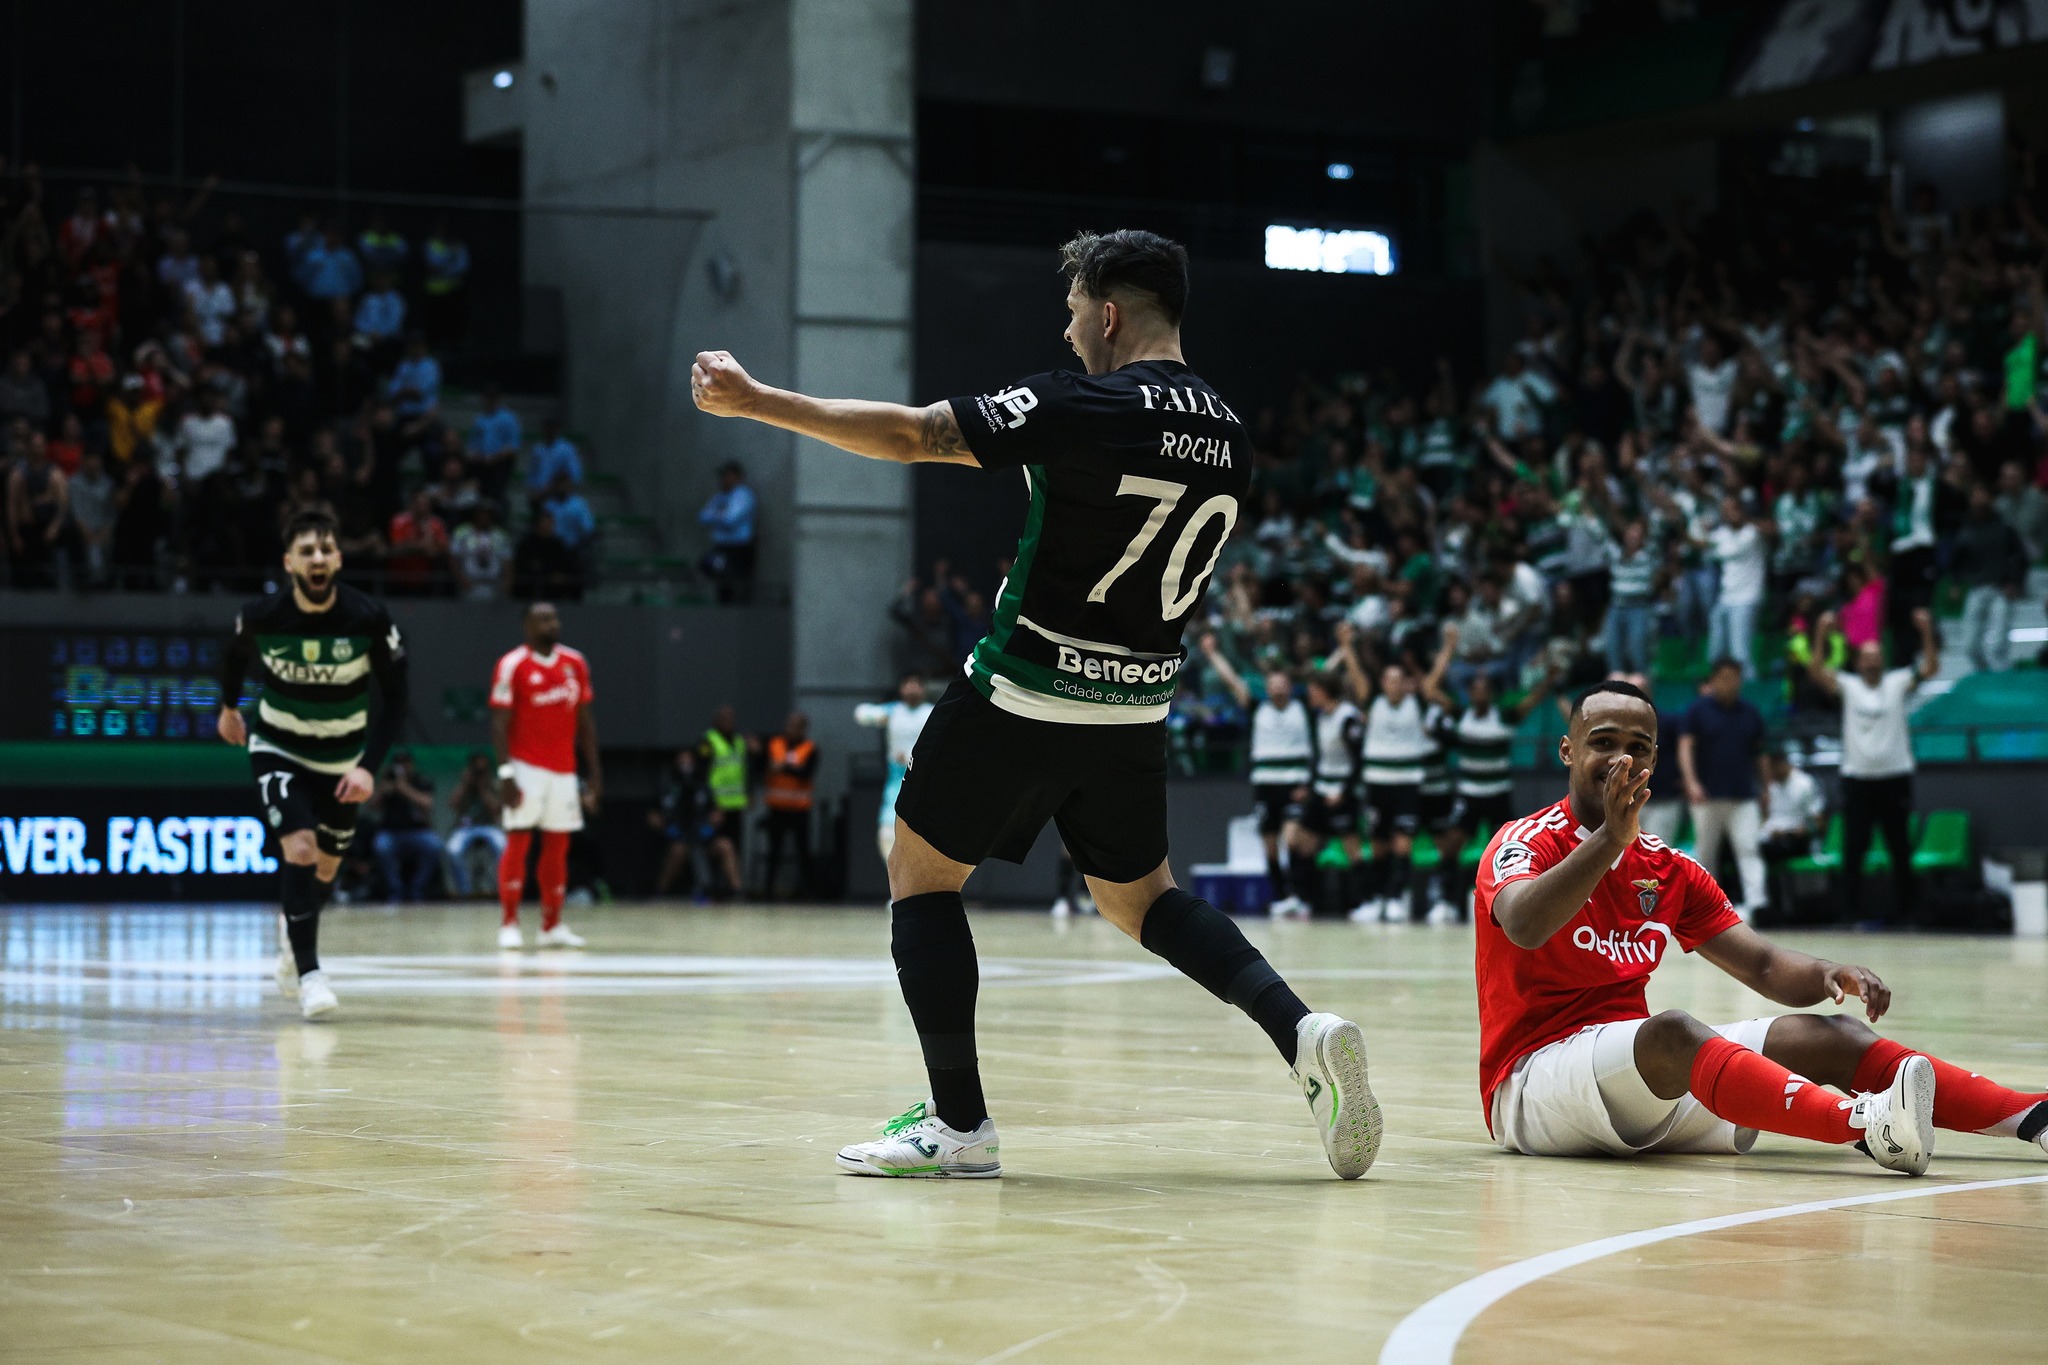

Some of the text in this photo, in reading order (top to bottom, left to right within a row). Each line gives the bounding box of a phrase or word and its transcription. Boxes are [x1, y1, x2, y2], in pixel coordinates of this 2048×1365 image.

[1160, 431, 1233, 469] ROCHA
[1086, 474, 1239, 622] 70
[1053, 679, 1103, 701] Cidade
[1105, 691, 1124, 704] do
[0, 816, 101, 874] VER.
[107, 816, 279, 874] FASTER.
